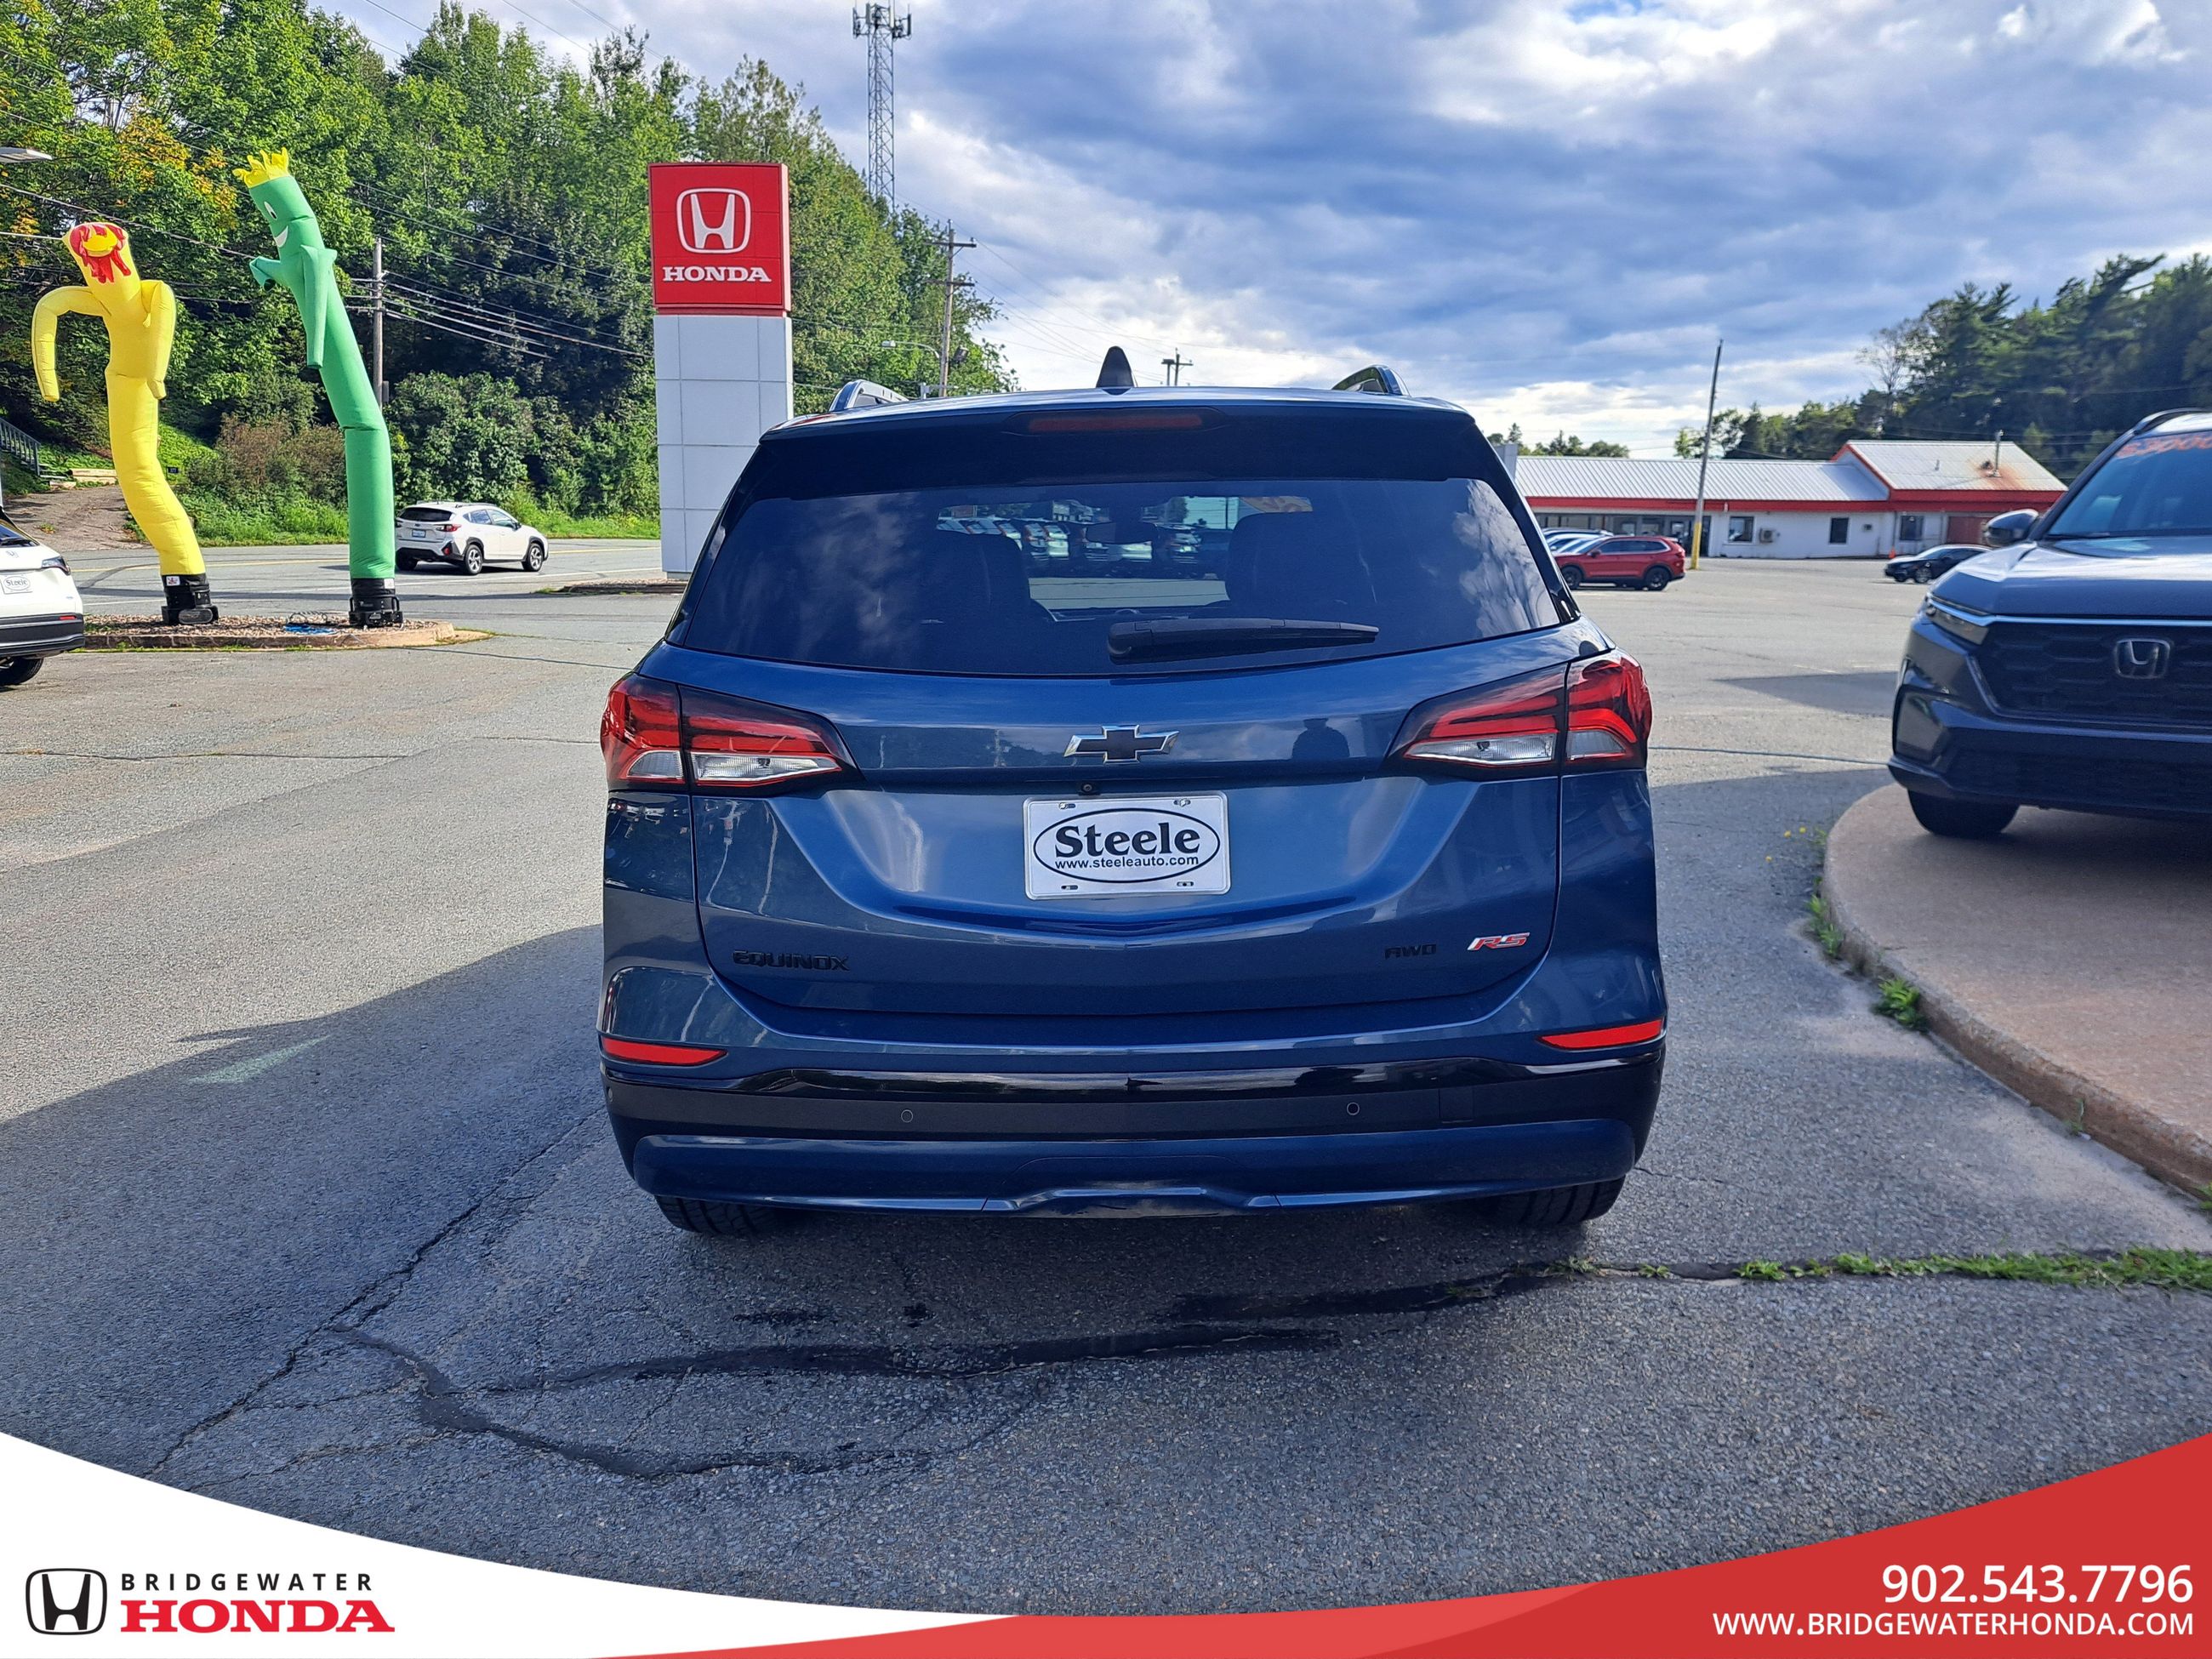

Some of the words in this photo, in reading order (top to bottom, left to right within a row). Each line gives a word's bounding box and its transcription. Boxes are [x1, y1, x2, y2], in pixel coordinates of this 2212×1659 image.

[662, 265, 772, 282] HONDA
[1054, 822, 1200, 858] Steele
[1055, 856, 1200, 869] www.steeleauto.com
[1384, 944, 1437, 960] AWD
[1467, 932, 1531, 951] RS
[733, 949, 851, 972] EQUINOX
